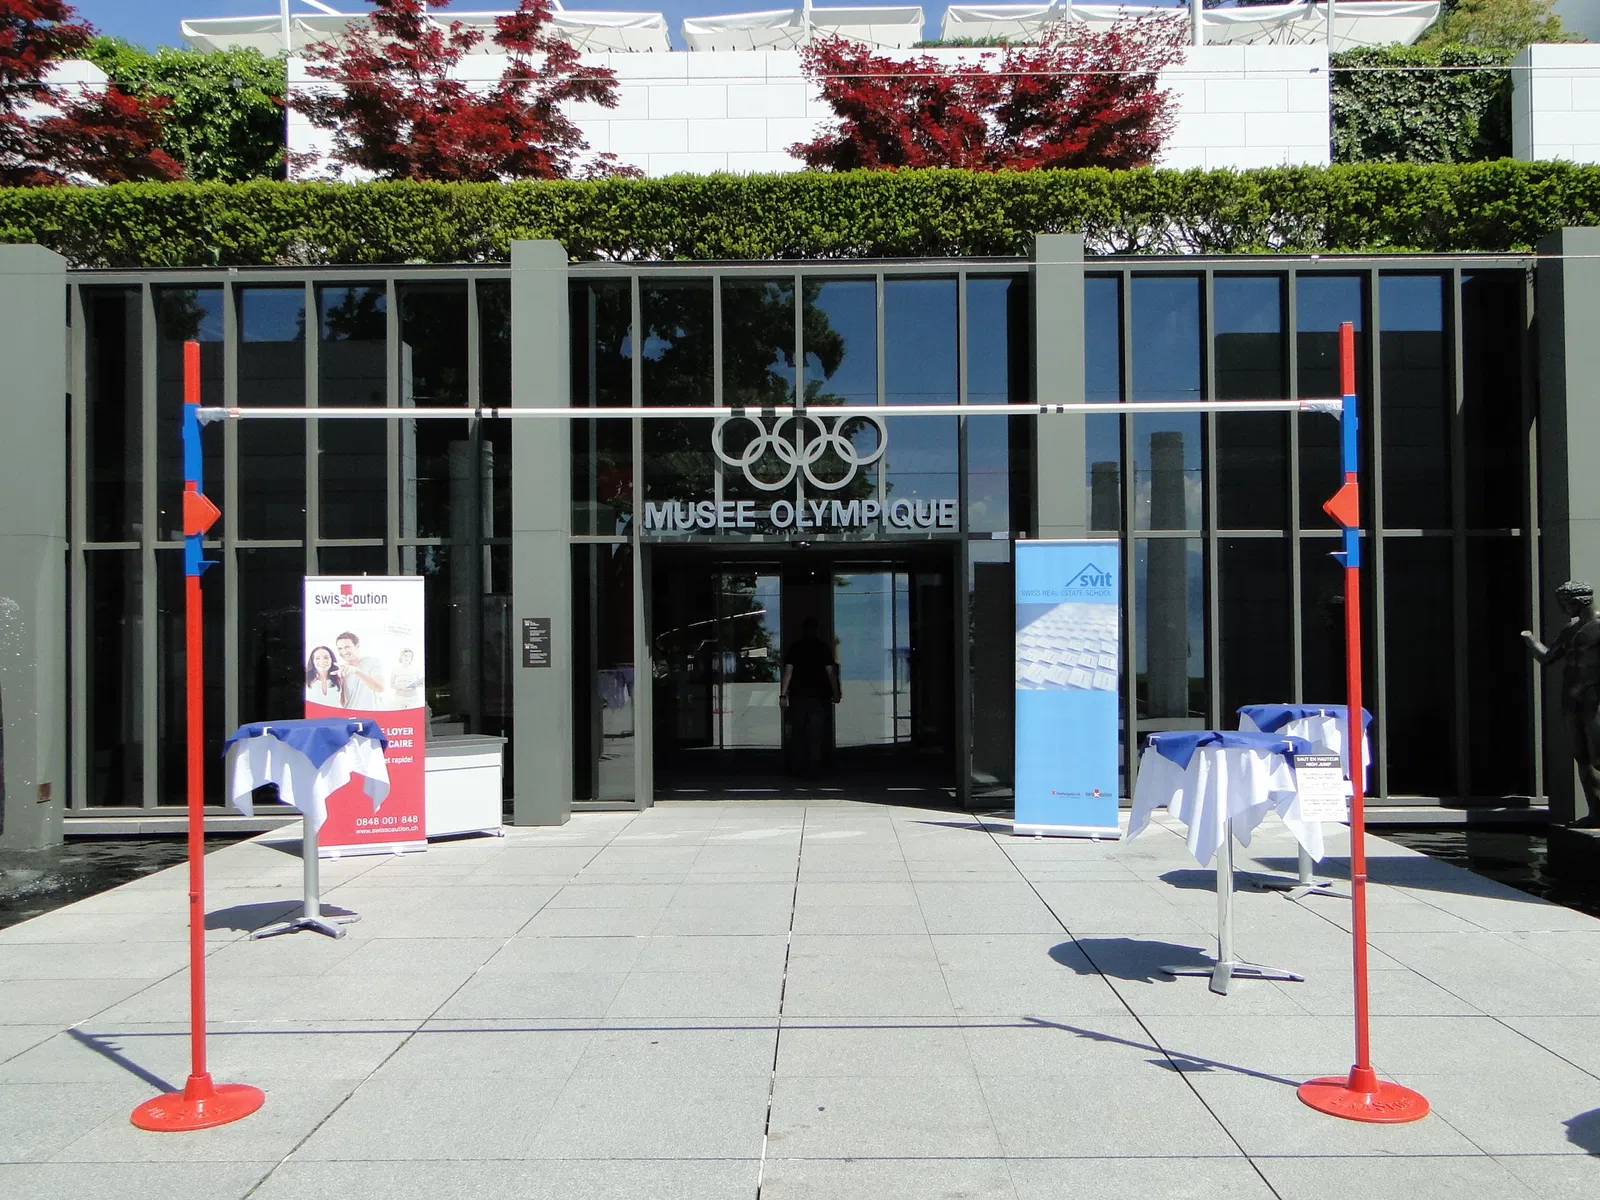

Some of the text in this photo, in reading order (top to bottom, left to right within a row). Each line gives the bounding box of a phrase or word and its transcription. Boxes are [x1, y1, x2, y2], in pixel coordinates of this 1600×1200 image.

[644, 499, 958, 529] MUSEE OLYMPIQUE
[1080, 573, 1112, 587] svit
[1021, 589, 1112, 597] SWISS REAL ESTATE SCHOOL
[315, 592, 388, 605] swisscaution
[387, 728, 414, 736] LOYER
[392, 756, 413, 764] rapide!
[356, 815, 419, 826] 0848 001 848
[356, 825, 418, 834] www.swisscaution.ch
